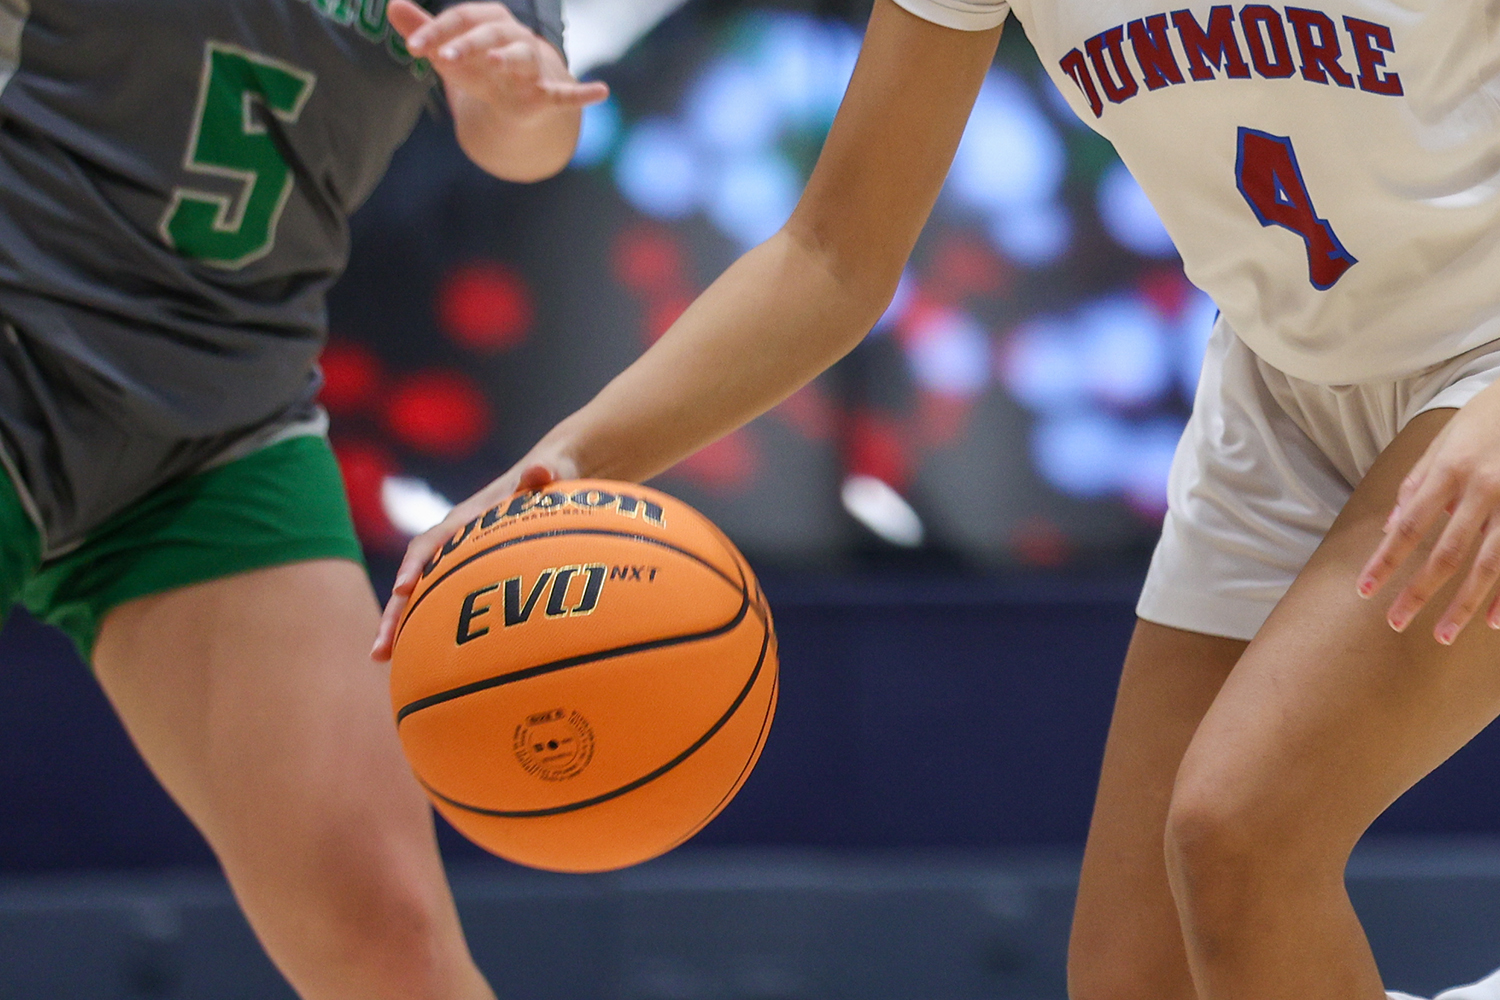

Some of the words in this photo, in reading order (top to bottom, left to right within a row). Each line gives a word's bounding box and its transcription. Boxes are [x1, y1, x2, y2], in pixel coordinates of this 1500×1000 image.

[1058, 3, 1404, 119] DUNMORE
[159, 40, 316, 270] 5
[1235, 125, 1359, 291] 4
[455, 562, 608, 647] EVO
[609, 564, 660, 582] NXT
